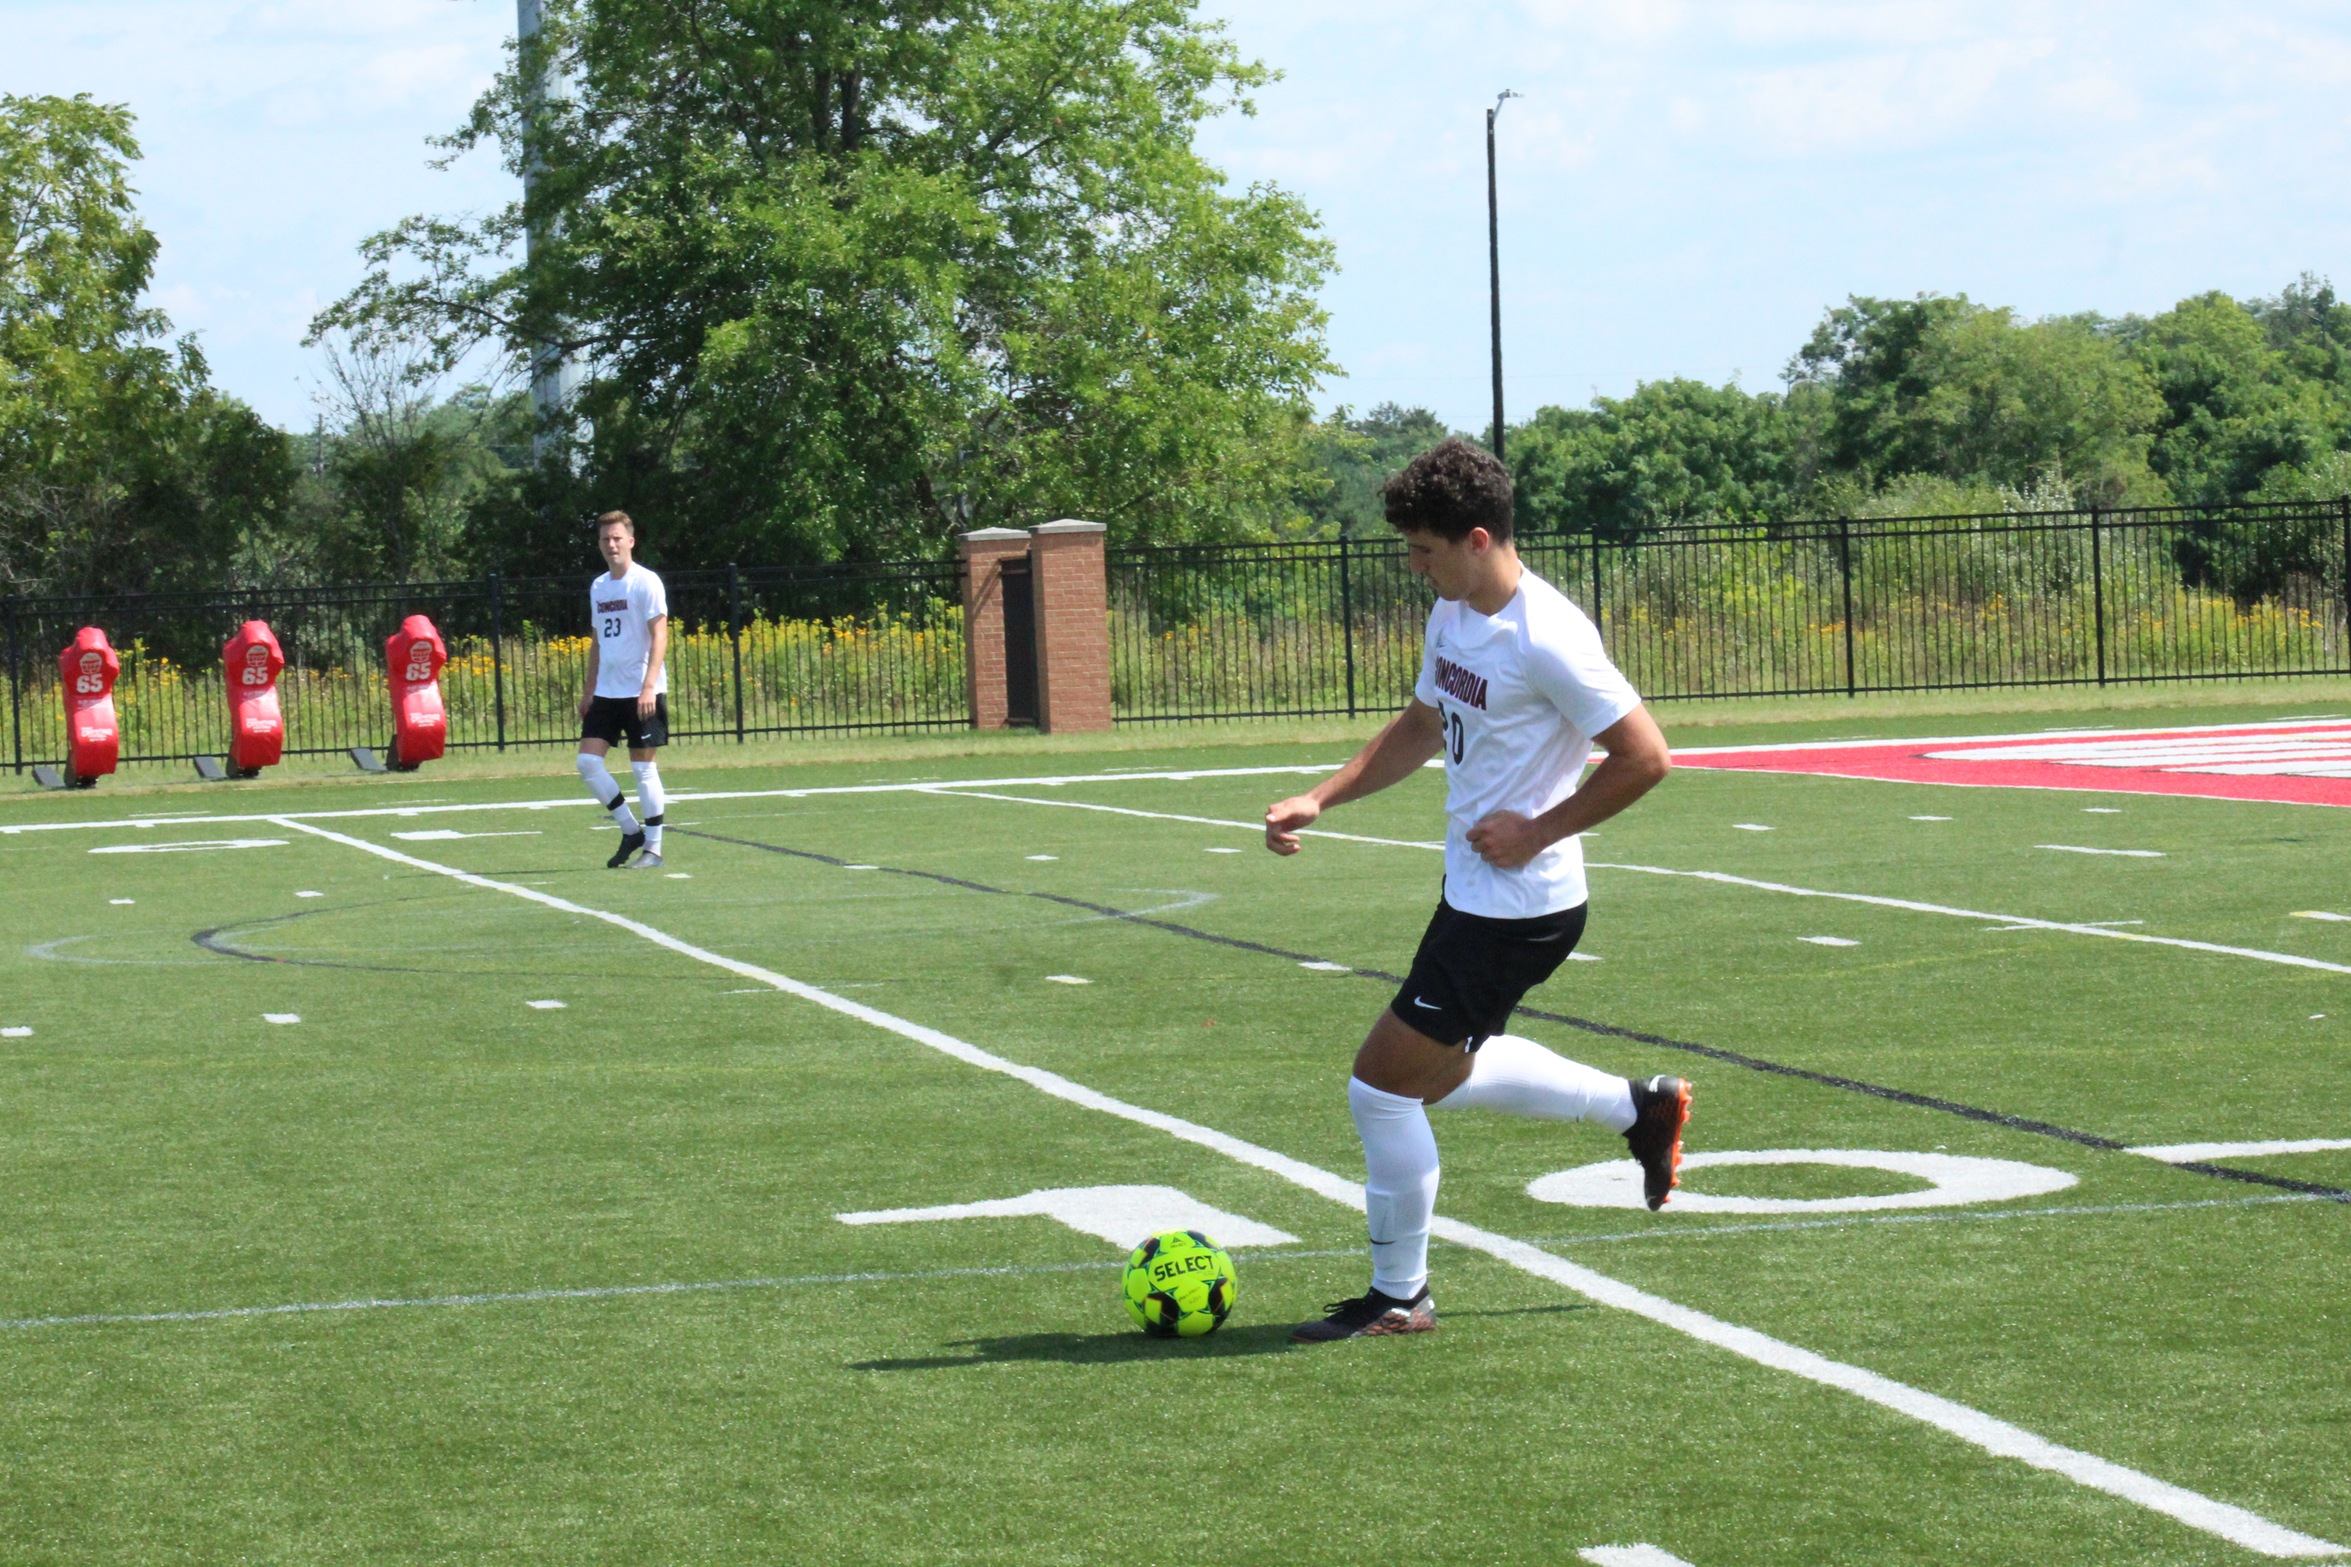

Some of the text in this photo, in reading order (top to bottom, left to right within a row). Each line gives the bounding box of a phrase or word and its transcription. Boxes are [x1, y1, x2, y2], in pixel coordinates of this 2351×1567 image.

[604, 617, 622, 638] 23
[241, 666, 268, 686] 65
[405, 662, 432, 681] 65
[76, 673, 103, 694] 65
[1434, 655, 1489, 711] ONCORDIA
[1153, 1255, 1215, 1282] SELECT
